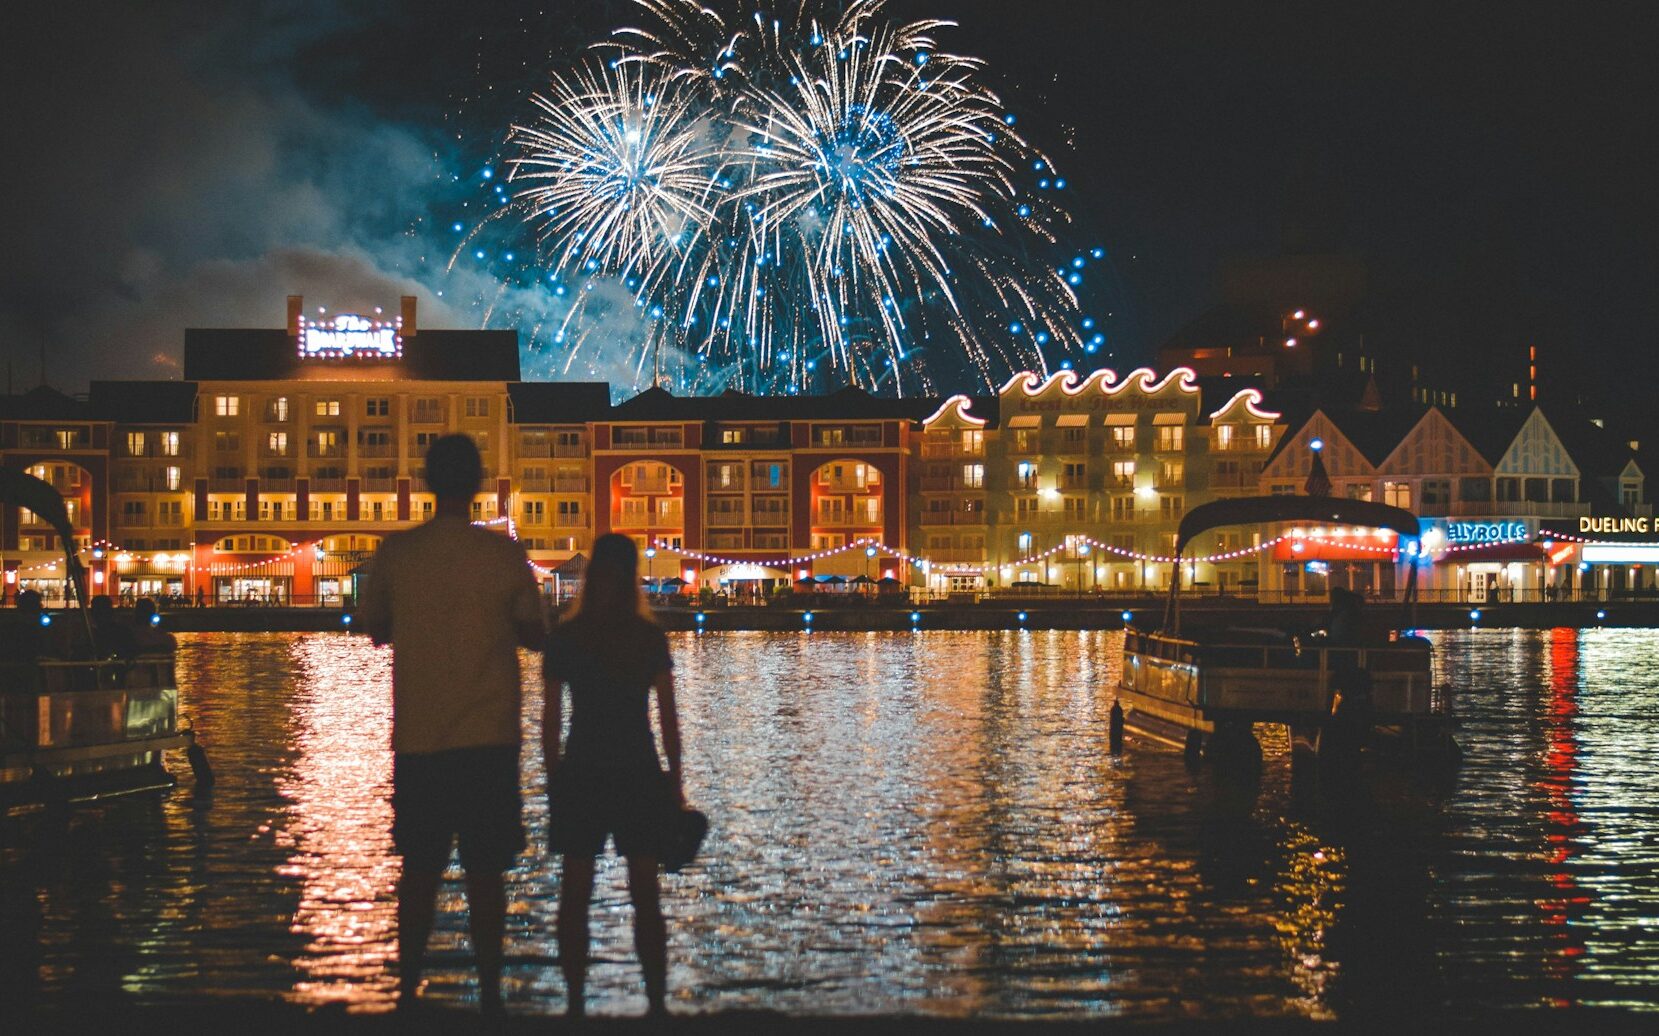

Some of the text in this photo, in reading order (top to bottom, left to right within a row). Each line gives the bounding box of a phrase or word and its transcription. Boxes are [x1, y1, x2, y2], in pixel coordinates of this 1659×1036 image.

[1020, 397, 1060, 411] Crest
[1089, 393, 1123, 411] The
[1128, 393, 1178, 410] Wave
[1447, 522, 1526, 542] ELLYROLLS
[1579, 516, 1648, 533] DUELING
